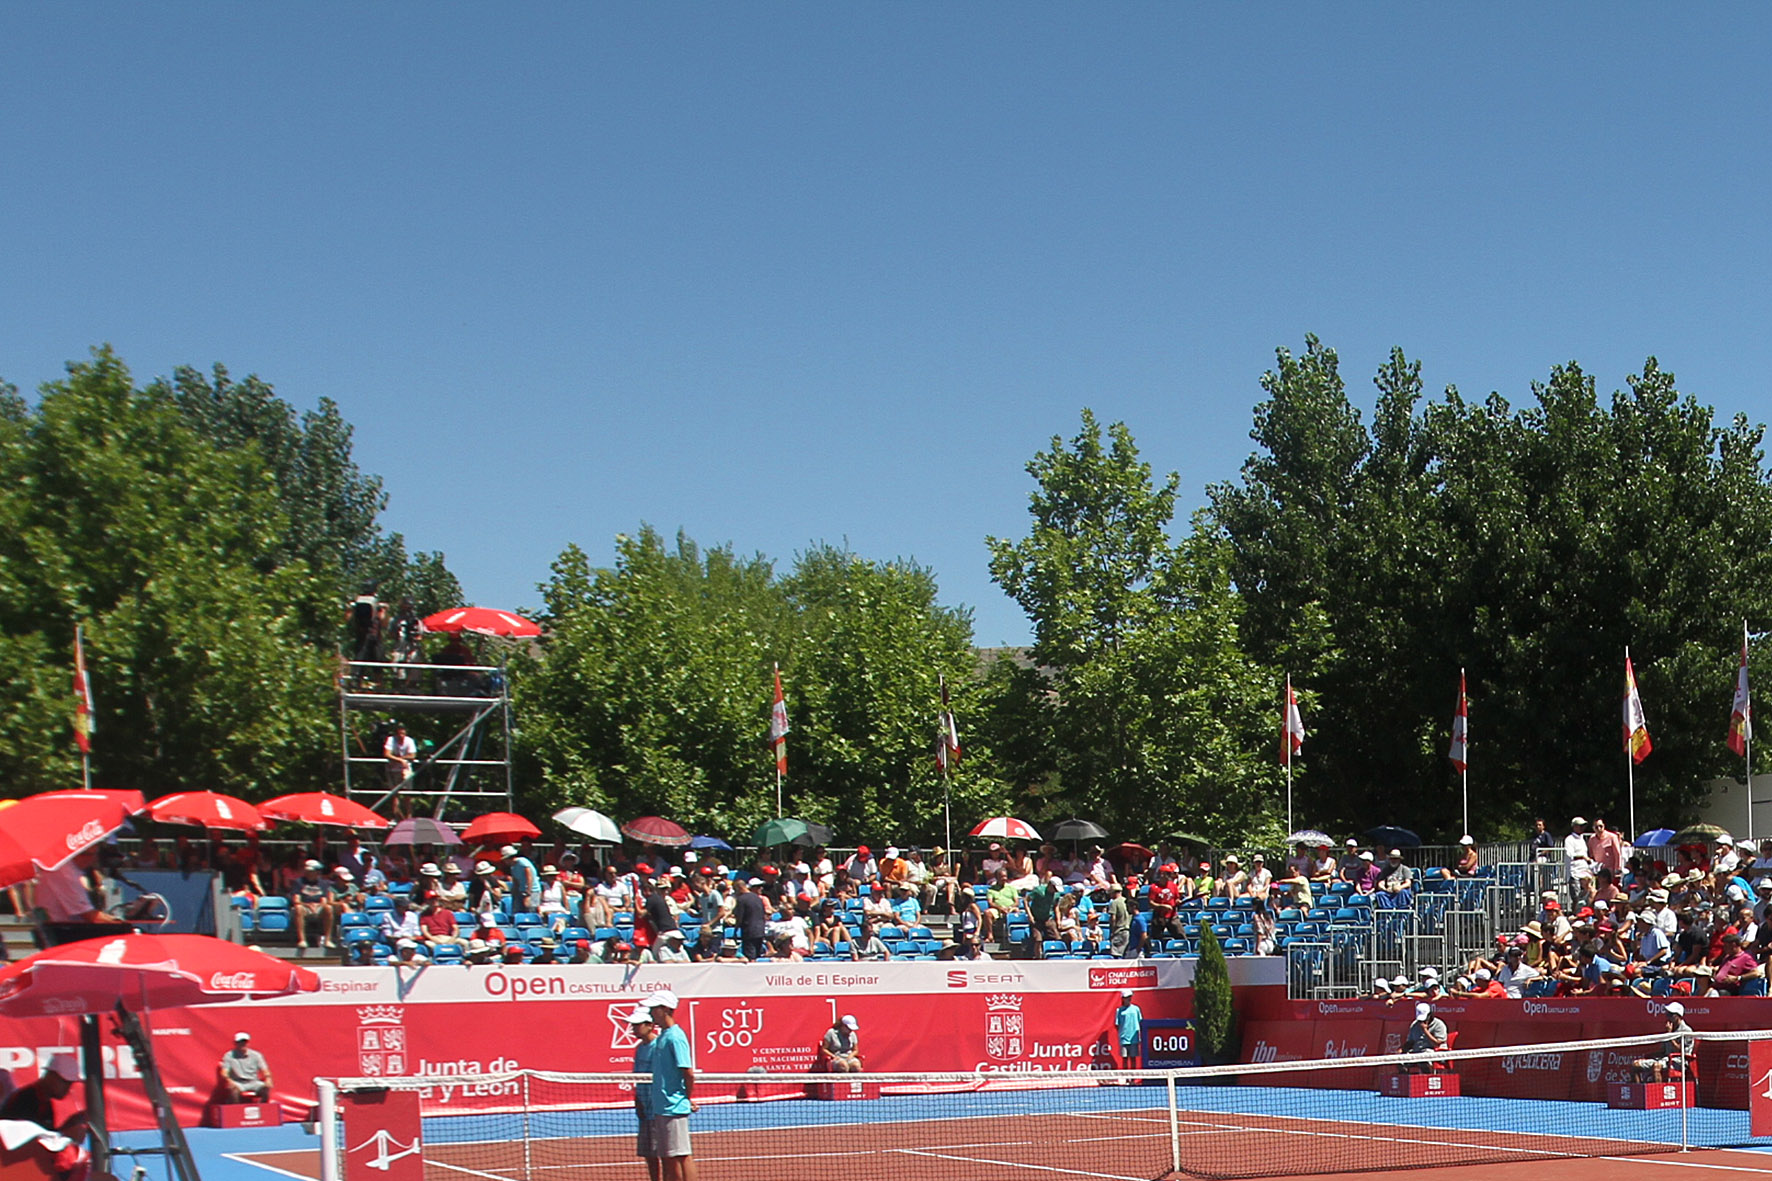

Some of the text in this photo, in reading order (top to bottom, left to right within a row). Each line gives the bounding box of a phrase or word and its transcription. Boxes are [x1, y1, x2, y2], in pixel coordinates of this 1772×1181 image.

[766, 974, 879, 988] Villa de El Espinar
[974, 974, 1024, 984] SEAT
[1108, 970, 1155, 978] CHALLENGER
[322, 980, 379, 993] Espinar
[484, 972, 671, 1000] Open CASTILLA Y LEÓN
[1319, 1002, 1338, 1015] Open
[1523, 1000, 1548, 1016] Open
[1646, 1000, 1666, 1017] Ope
[706, 1030, 753, 1053] 500
[1153, 1036, 1188, 1051] 0:00
[760, 1047, 811, 1055] CENTENARIO
[1029, 1041, 1112, 1058] Junta de
[414, 1057, 518, 1076] Junta de
[1515, 1053, 1562, 1070] KYOCERA
